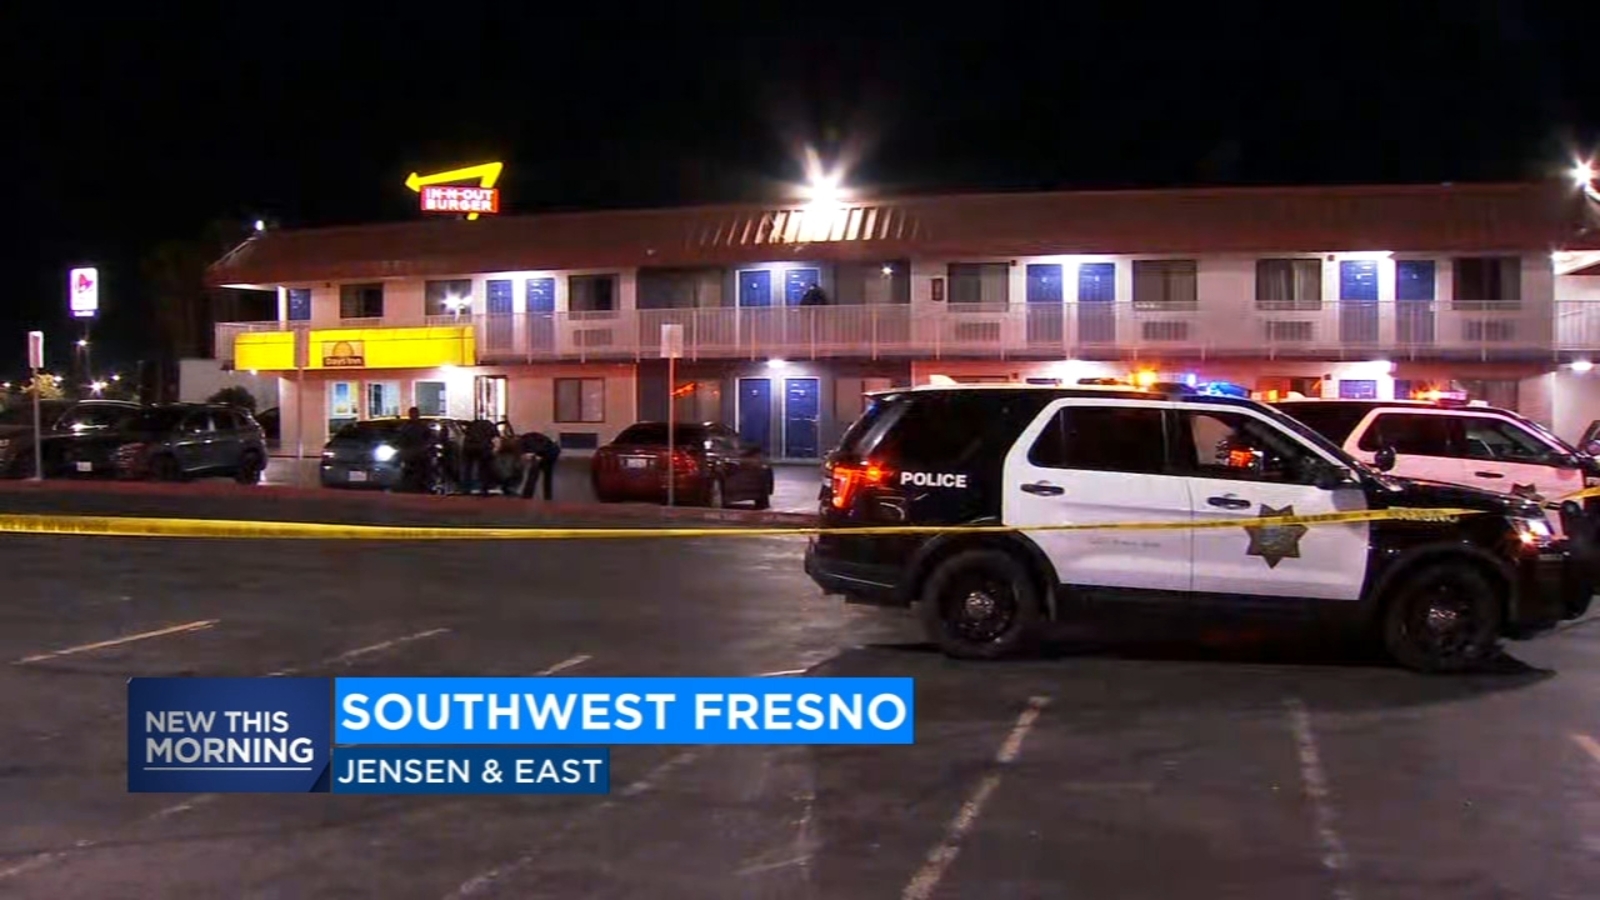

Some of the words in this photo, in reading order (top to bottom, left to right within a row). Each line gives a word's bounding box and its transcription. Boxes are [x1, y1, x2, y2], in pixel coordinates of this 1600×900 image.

[425, 188, 494, 200] IN-N-OUT
[425, 199, 492, 211] BURGER
[900, 471, 968, 489] POLICE
